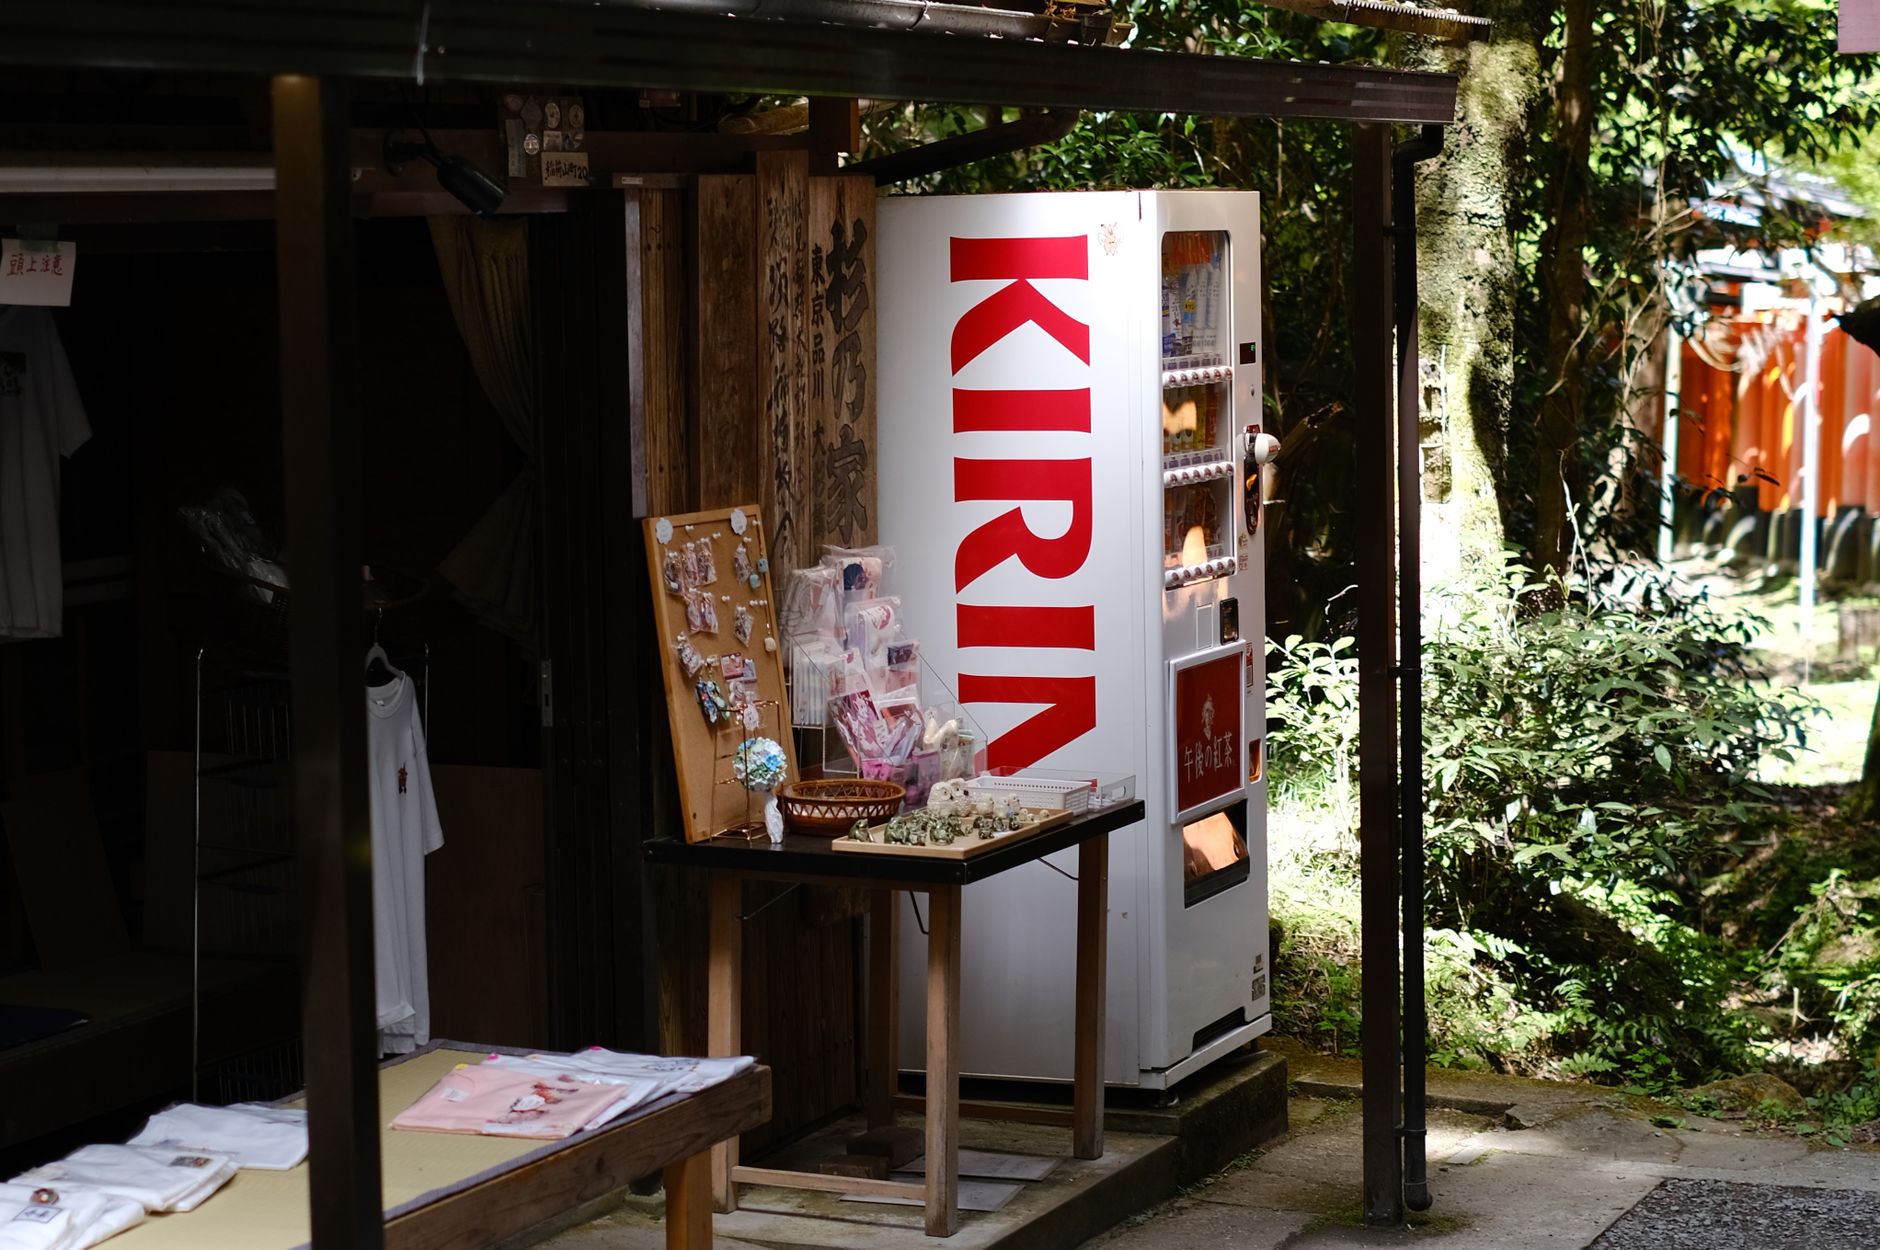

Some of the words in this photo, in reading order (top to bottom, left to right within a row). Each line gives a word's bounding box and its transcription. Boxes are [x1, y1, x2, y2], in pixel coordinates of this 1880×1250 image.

[7, 253, 63, 277] 頭上注意
[810, 242, 825, 403] 東京品川
[952, 235, 1096, 776] KIRIN
[1184, 730, 1234, 783] 午後の紅茶
